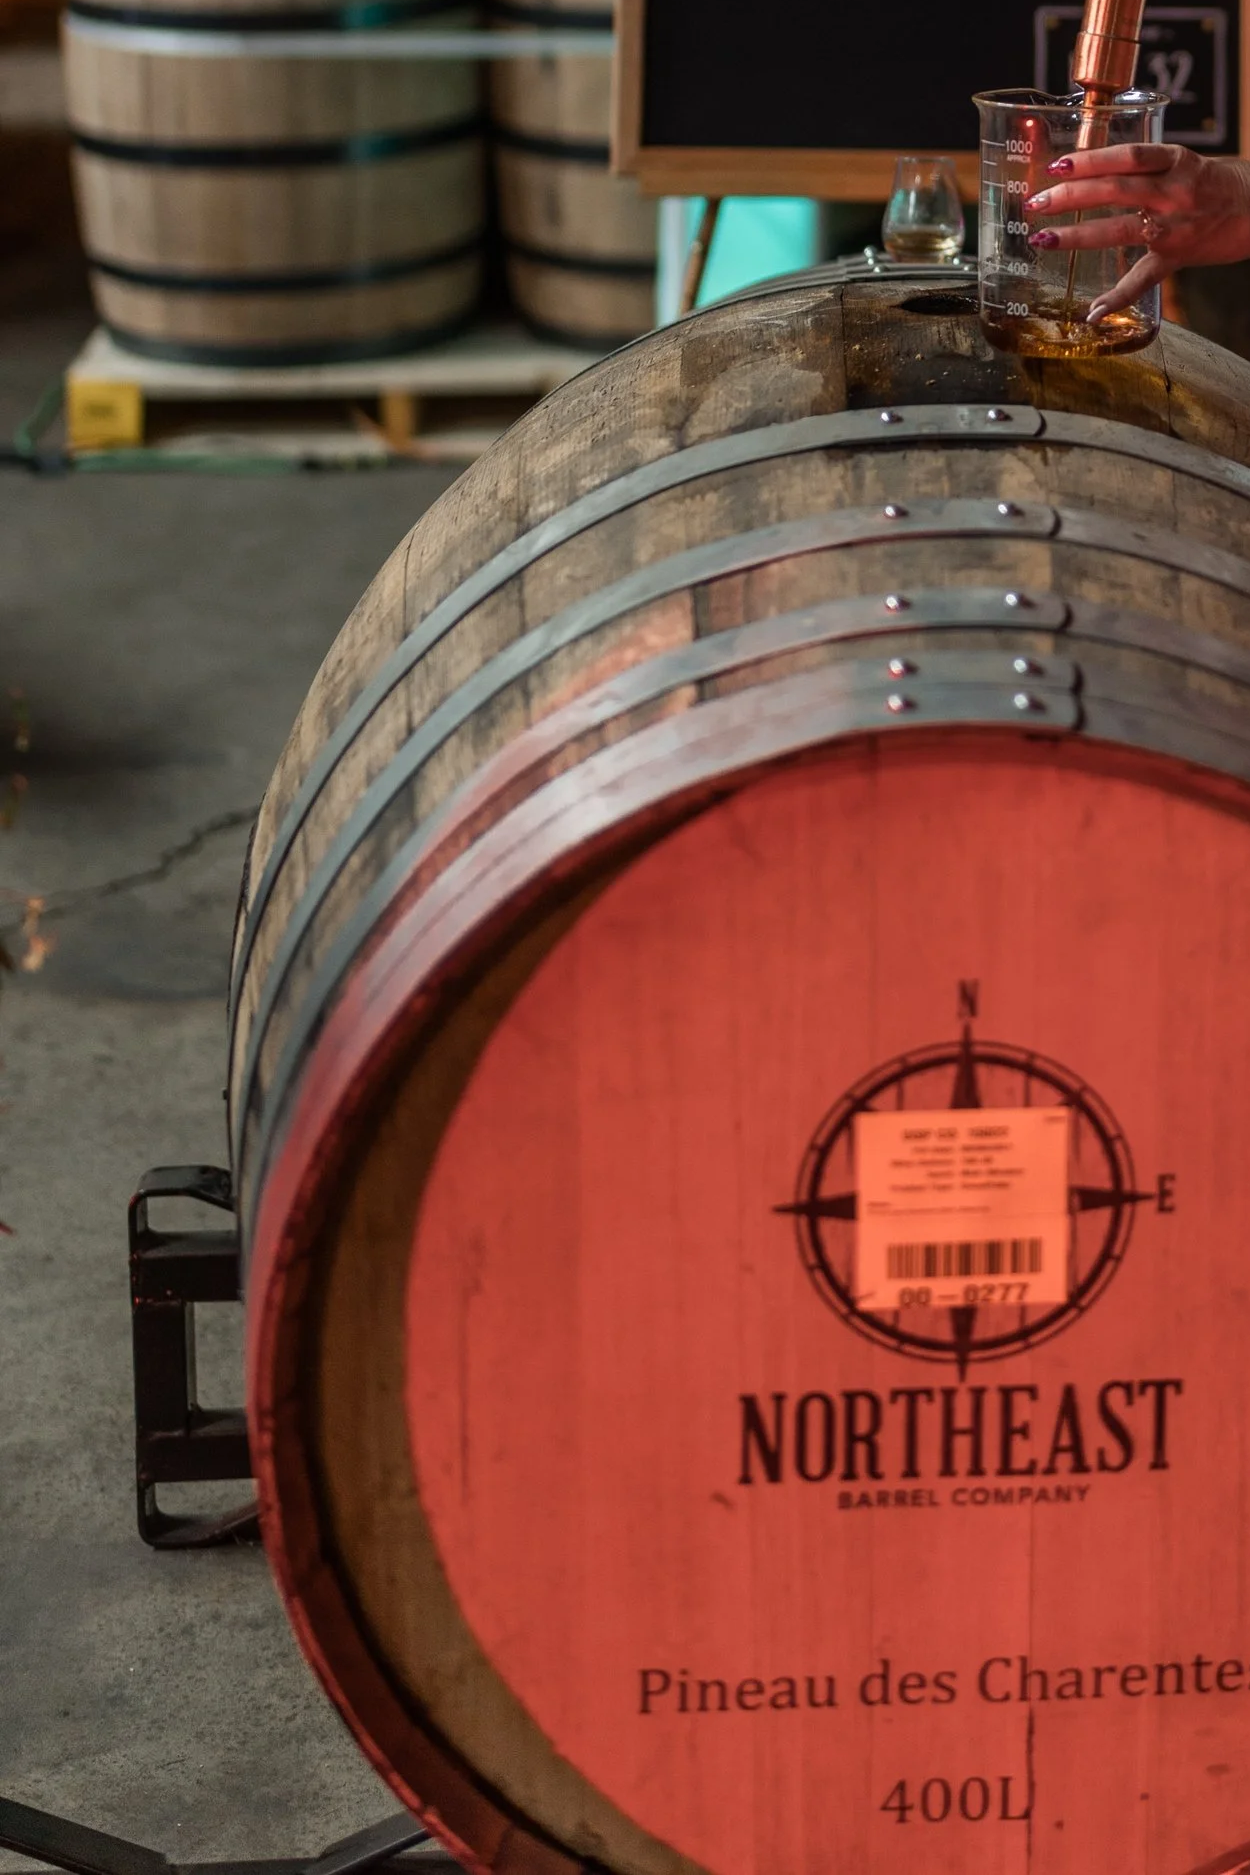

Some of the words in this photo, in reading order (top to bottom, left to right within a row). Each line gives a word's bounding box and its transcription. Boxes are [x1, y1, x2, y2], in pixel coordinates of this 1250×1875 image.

[1005, 139, 1033, 154] 1000
[1006, 181, 1029, 194] 800
[1007, 222, 1029, 235] 600
[1007, 262, 1029, 275] 400
[1006, 302, 1029, 317] 200
[957, 979, 979, 1019] N
[1156, 1174, 1176, 1213] E
[738, 1379, 1183, 1484] NORTHEAST
[838, 1488, 941, 1509] BARREL
[951, 1484, 1092, 1506] COMPANY
[637, 1667, 838, 1714] Pineau
[859, 1659, 958, 1707] des
[880, 1777, 1032, 1824] 400L
